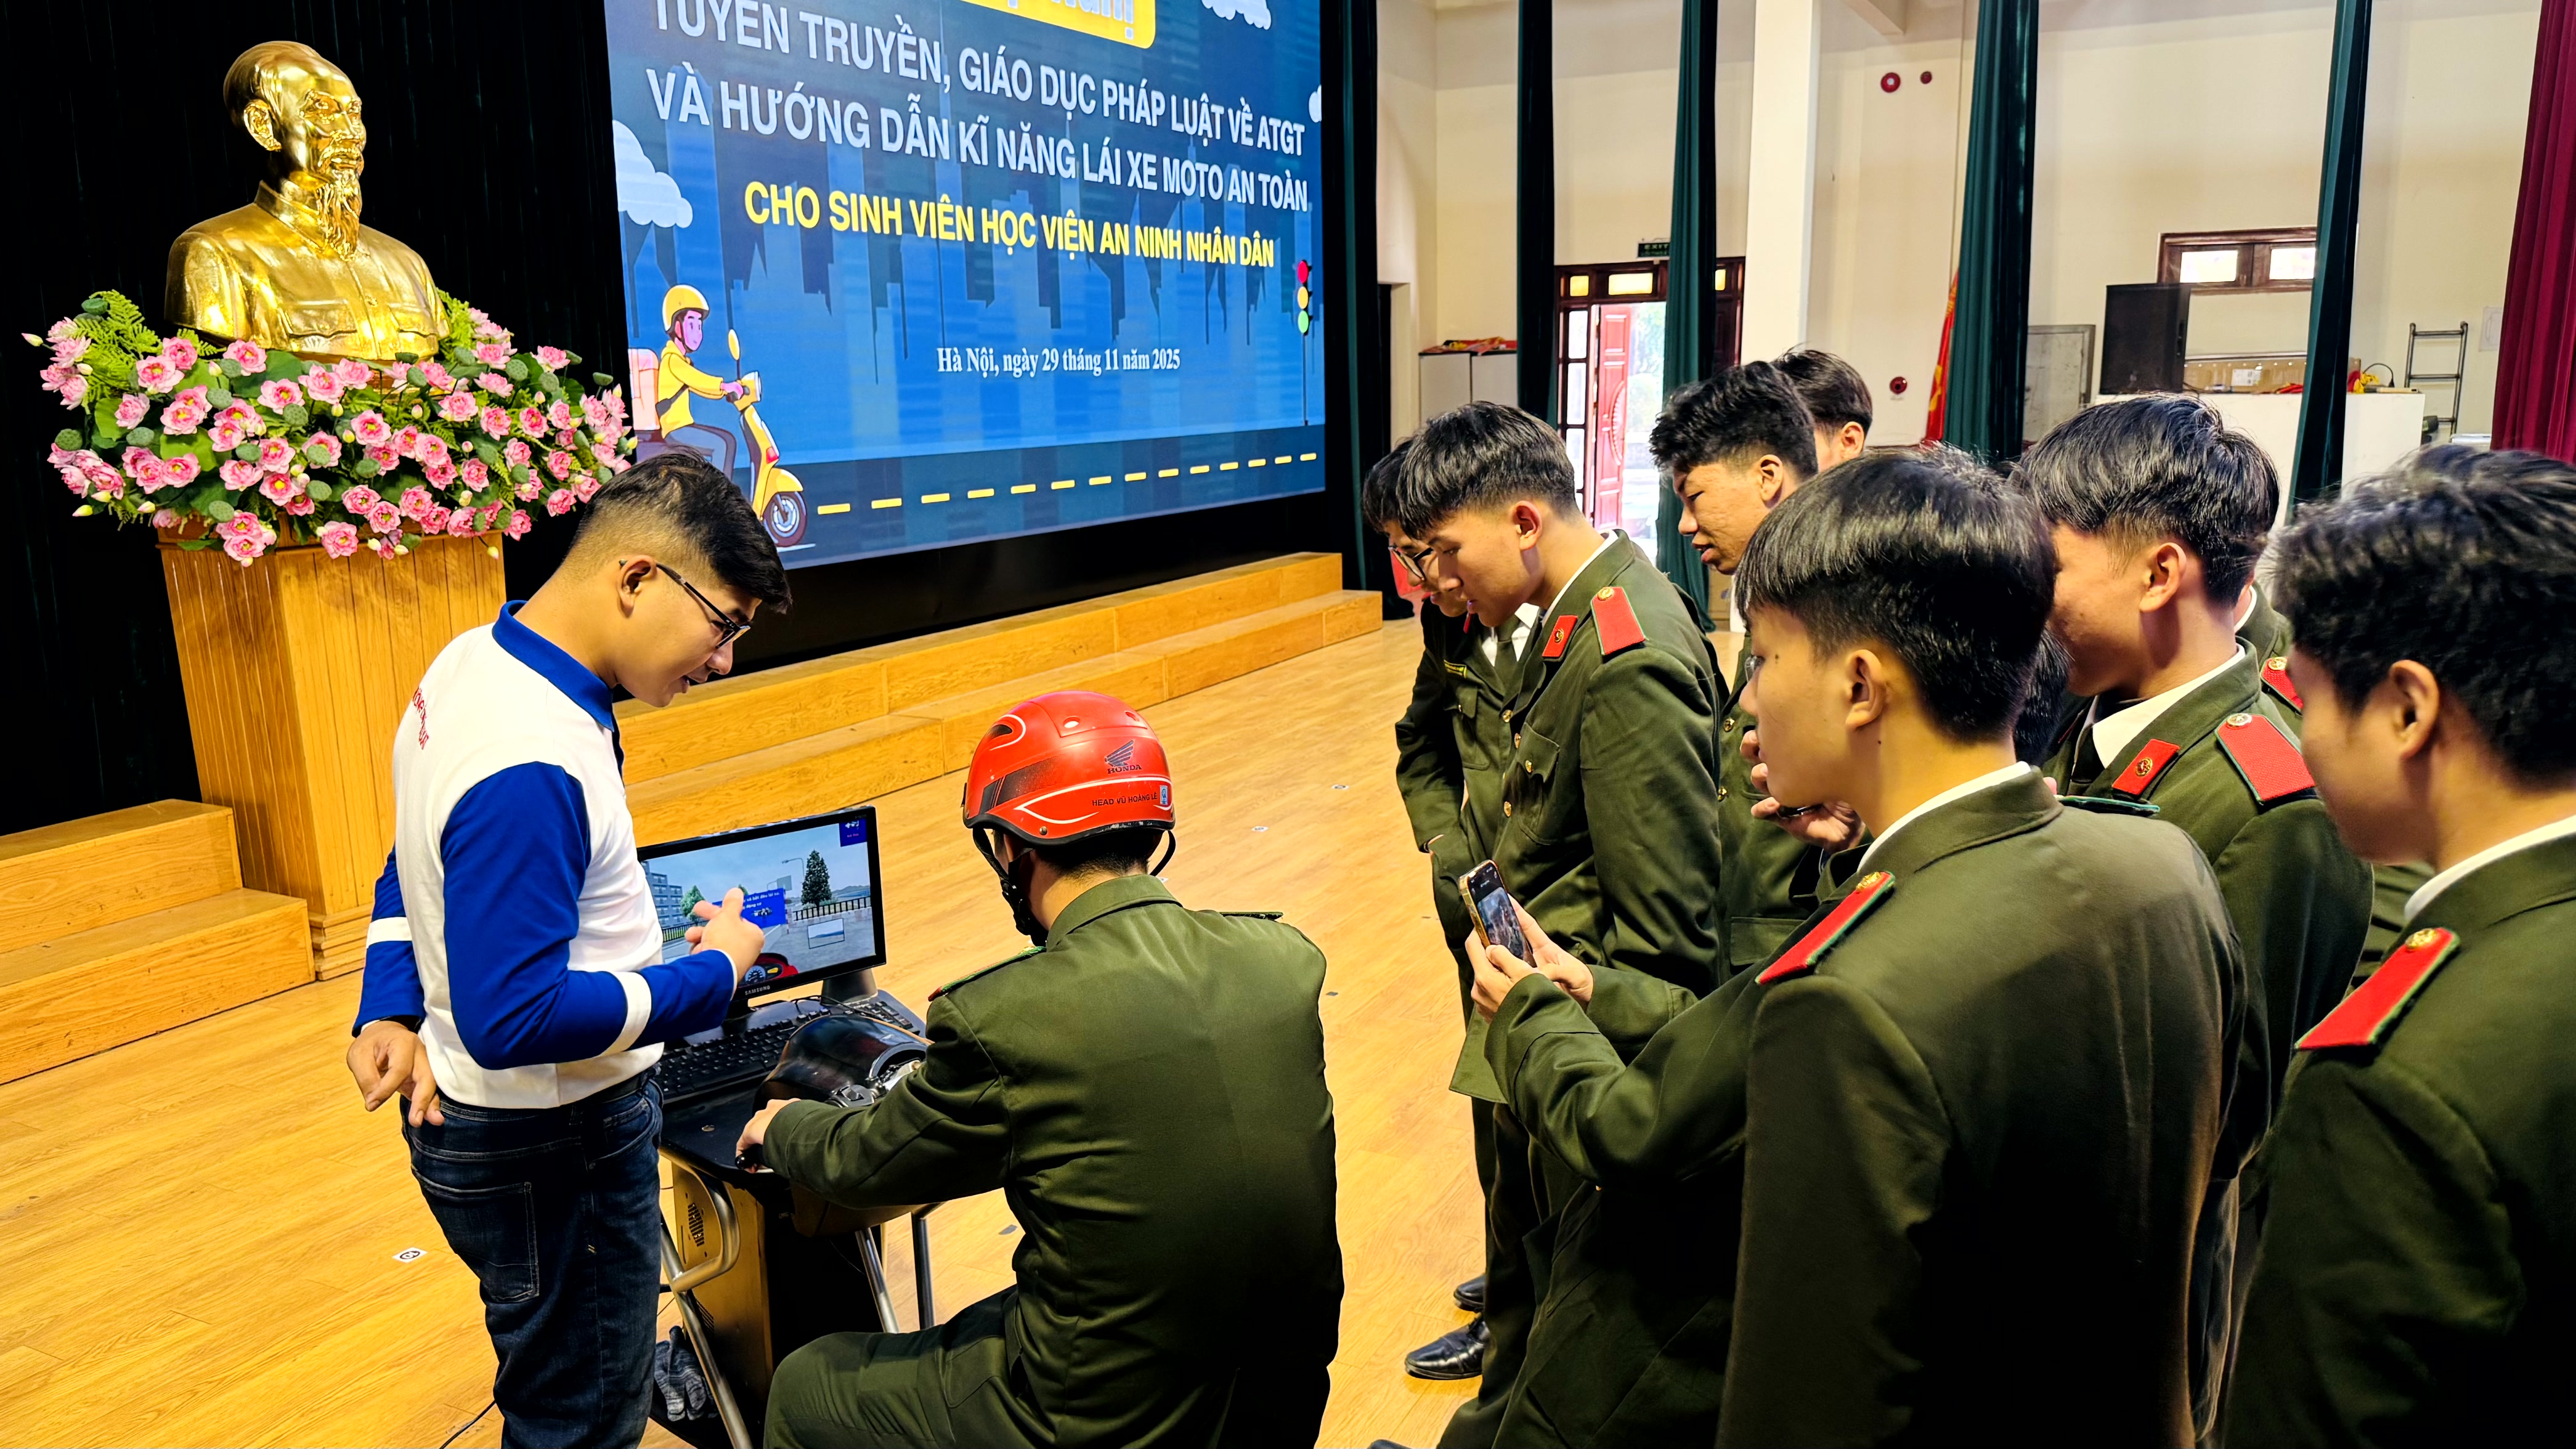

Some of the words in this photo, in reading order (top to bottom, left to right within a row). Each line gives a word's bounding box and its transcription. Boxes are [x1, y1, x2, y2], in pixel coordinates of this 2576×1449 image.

[798, 11, 951, 93] TRUYỀN,
[959, 44, 1033, 101] GIÁO
[1040, 65, 1096, 121] DỤC
[1102, 78, 1166, 127] PHÁP
[1171, 92, 1224, 147] LUẬT
[1227, 96, 1254, 147] VỀ
[1257, 115, 1306, 156] ATGT
[646, 60, 710, 126] VÀ
[720, 81, 871, 148] HƯỚNG
[880, 93, 950, 160] DẪN
[958, 114, 989, 166] KĨ
[996, 121, 1076, 179] NĂNG
[1083, 136, 1121, 185] LÁI
[1126, 150, 1158, 191] XE
[1163, 156, 1224, 200] MOTO
[1227, 168, 1255, 205] AN
[1258, 169, 1307, 213] TOÀN
[744, 181, 821, 229] CHO
[829, 190, 903, 235] SINH
[909, 194, 975, 242] VIÊN
[981, 208, 1036, 255] HỌC
[1041, 209, 1094, 261] VIỆN
[1099, 221, 1130, 256] AN
[1135, 225, 1182, 260] NINH
[1186, 225, 1236, 265] NHÂN
[1240, 230, 1274, 268] DÂN
[937, 347, 962, 372] Hà
[966, 347, 999, 378] Nội,
[1002, 347, 1039, 378] ngày
[1041, 348, 1059, 371] 29
[1062, 348, 1102, 376] tháng
[1105, 349, 1118, 370] 11
[1122, 349, 1150, 370] năm
[1152, 349, 1180, 370] 2025
[1107, 765, 1142, 773] HONDA
[745, 985, 770, 995] SAMSUNG
